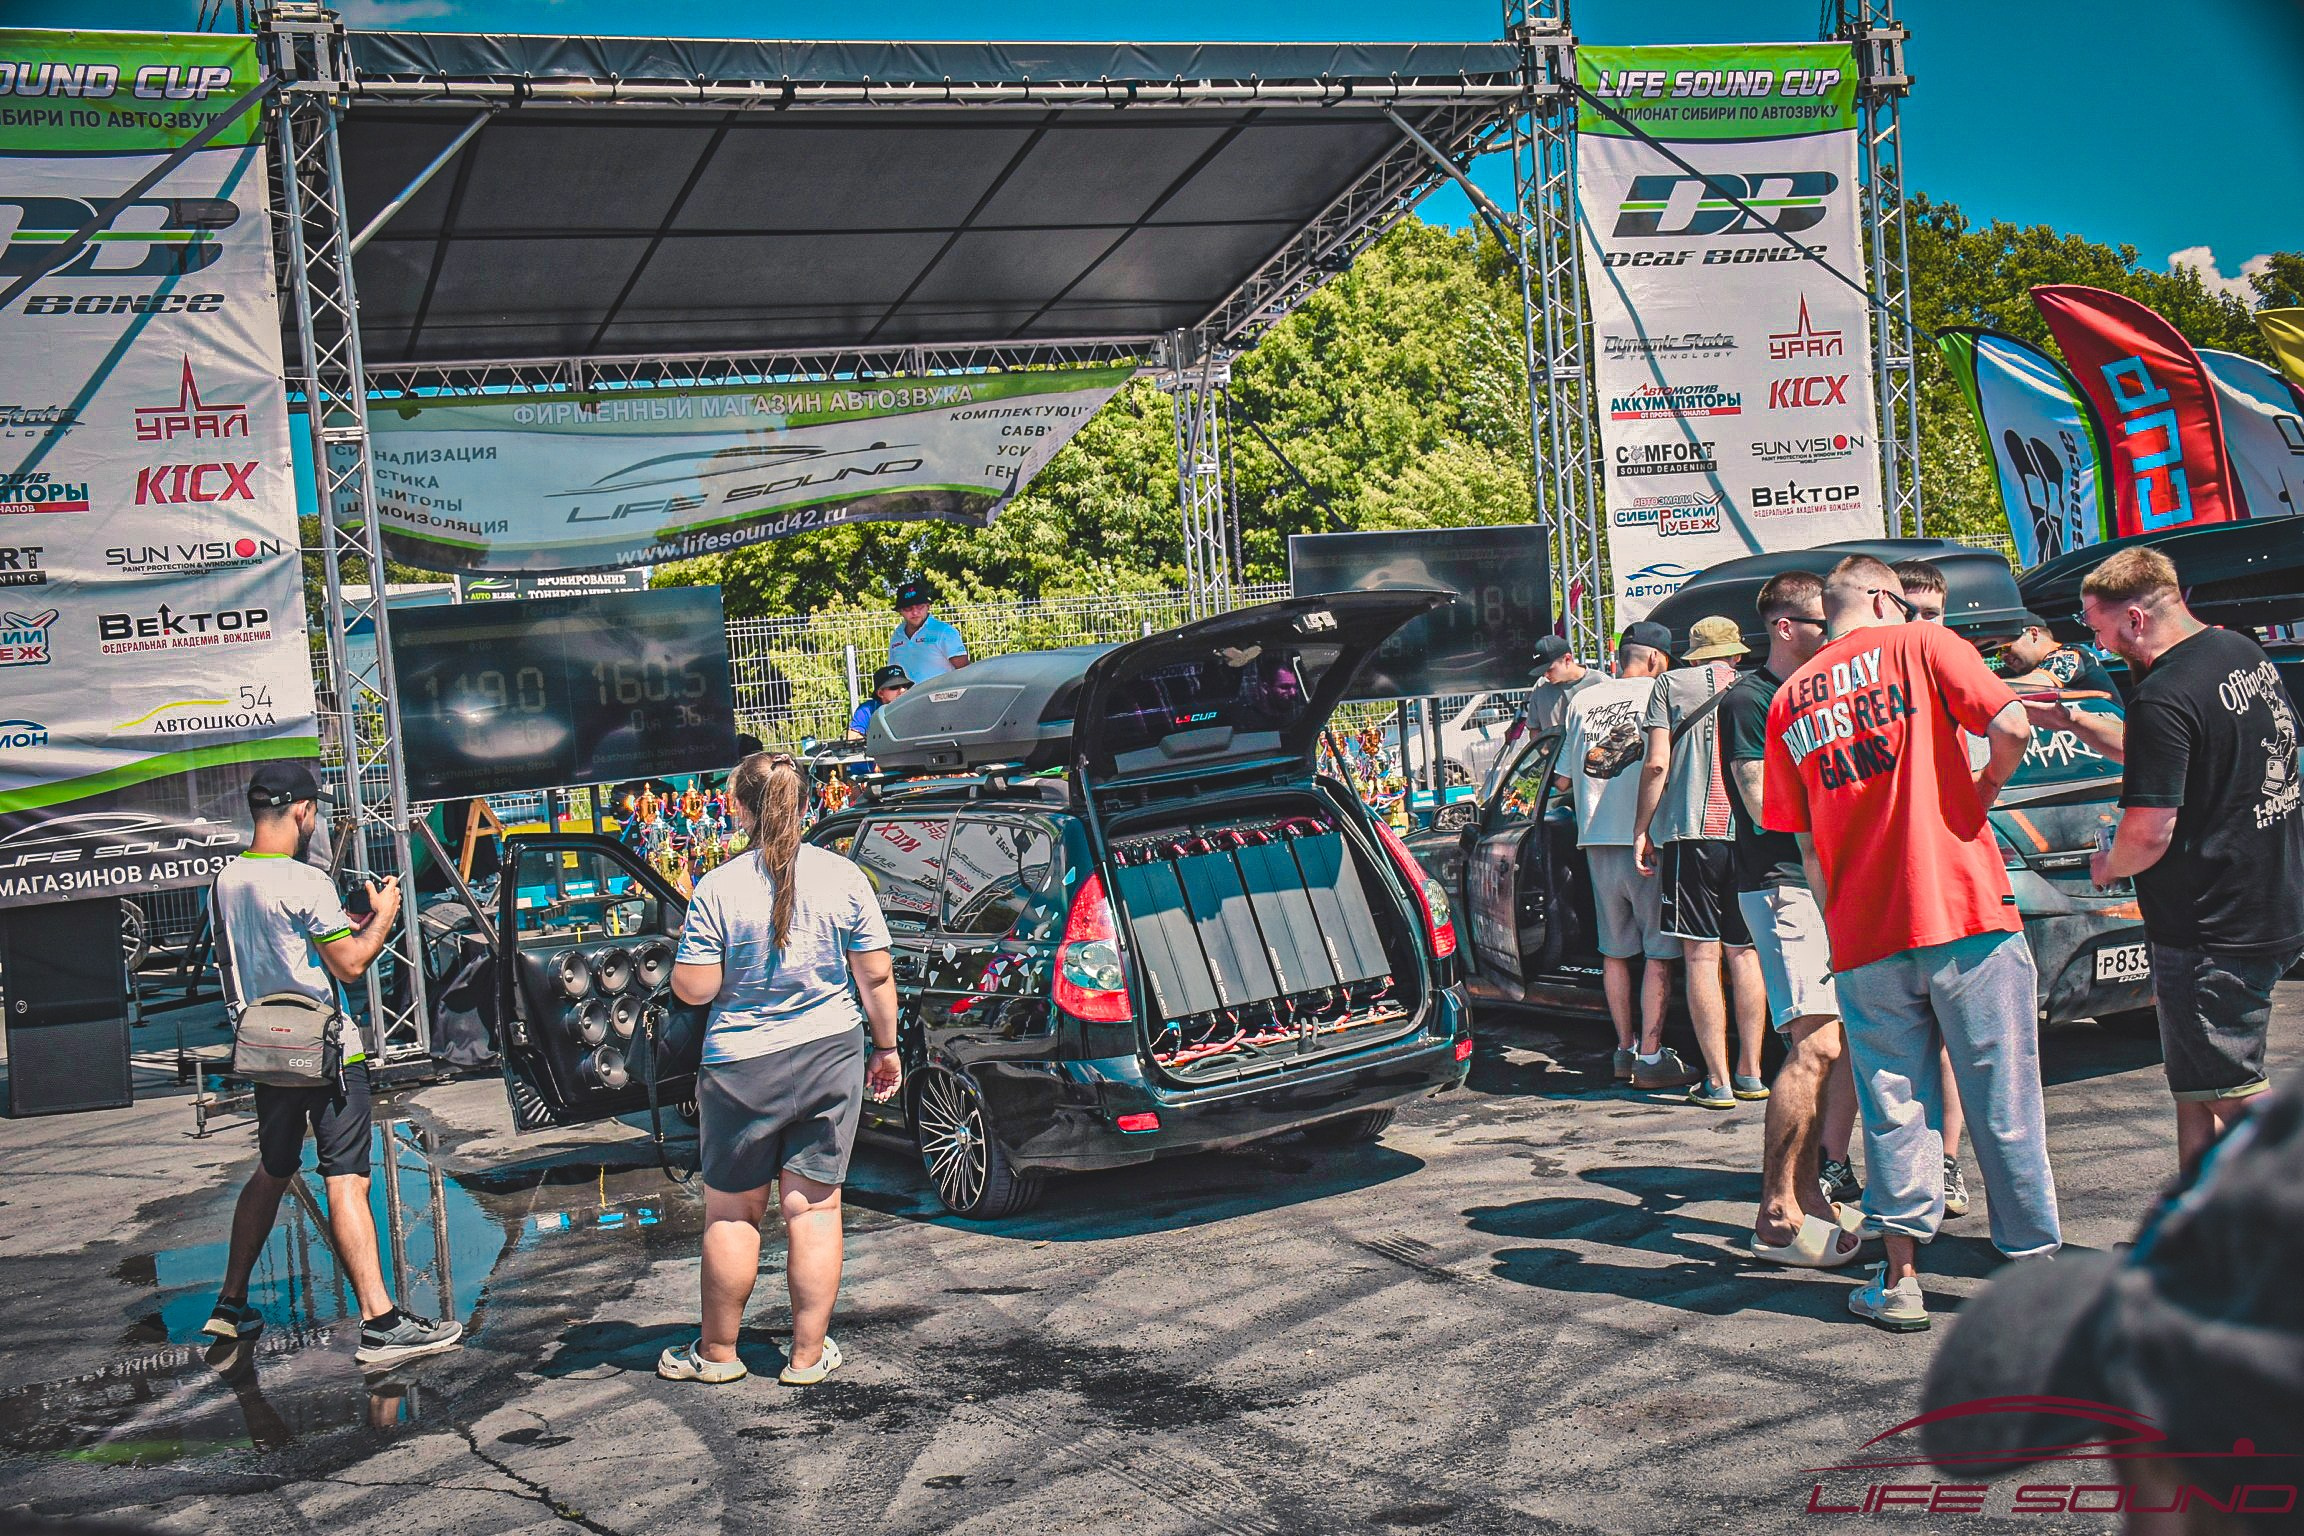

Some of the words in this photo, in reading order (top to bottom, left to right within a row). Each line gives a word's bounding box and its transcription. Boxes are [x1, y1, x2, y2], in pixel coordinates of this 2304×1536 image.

[133, 64, 232, 100] CUP
[1596, 70, 1667, 98] LIFE
[1671, 70, 1773, 98] SOUND
[1781, 69, 1840, 97] CUP
[0, 109, 63, 126] БИРИ
[70, 111, 101, 127] ПО
[107, 112, 224, 128] АВТОЗВУК
[1682, 107, 1736, 120] СИБИРИ
[1740, 106, 1758, 120] ПО
[1761, 105, 1838, 119] АВТОЗВУКУ
[1604, 335, 1680, 355] Dynamic
[1683, 332, 1739, 350] State
[1769, 340, 1843, 360] УРАЛ
[1630, 352, 1731, 361] TECHNOLOGY
[1611, 393, 1741, 412] АККУМУЛЯТОРЫ
[1769, 374, 1849, 409] KICX
[513, 393, 693, 425] ФИРМЕННЫЙ
[701, 392, 821, 418] МАГАЗИН
[829, 385, 973, 413] АВТОЗВУКА
[136, 415, 249, 441] УРАЛ
[1001, 425, 1053, 437] САБВ
[335, 446, 497, 465] СИНАЛИЗАЦИЯ
[1751, 441, 1791, 456] SUN
[1796, 435, 1864, 452] VISION
[337, 464, 440, 488] АКСТИКА
[1620, 465, 1652, 475] SOUND
[1657, 463, 1713, 472] DEADENING
[135, 462, 259, 505] KICX
[566, 494, 708, 523] LIFE
[722, 459, 924, 504] SOUND
[340, 502, 509, 536] ШМОИЗОЛЯЦИЯ
[1753, 509, 1793, 517] ФЕДЕРАЛЬНАЯ
[616, 506, 849, 566] www.lifesound42.ru
[106, 546, 170, 566] SUN
[177, 538, 281, 561] VISION
[123, 565, 145, 573] PAINT
[146, 563, 195, 571] PROTECTION
[240, 558, 262, 566] FILMS
[102, 639, 167, 655] ФЕДЕРАЛЬНАЯ
[172, 635, 219, 648] АКАДЕМИЯ
[223, 630, 271, 645] ВОЖДЕНИЯ
[591, 658, 707, 706] 160.5
[1788, 673, 1828, 714] LEG
[1832, 647, 1881, 697] DAY
[240, 685, 272, 710] 54
[154, 712, 276, 734] АВТОШКОЛА
[1586, 700, 1632, 724] SPARTA
[1593, 711, 1638, 731] MARKET
[1781, 702, 1853, 766] BUILDS
[1854, 680, 1917, 731] REAL
[1584, 733, 1600, 743] TEAM
[1820, 735, 1896, 789] GAINS
[93, 833, 240, 859] SOUND
[289, 1059, 313, 1067] EOS
